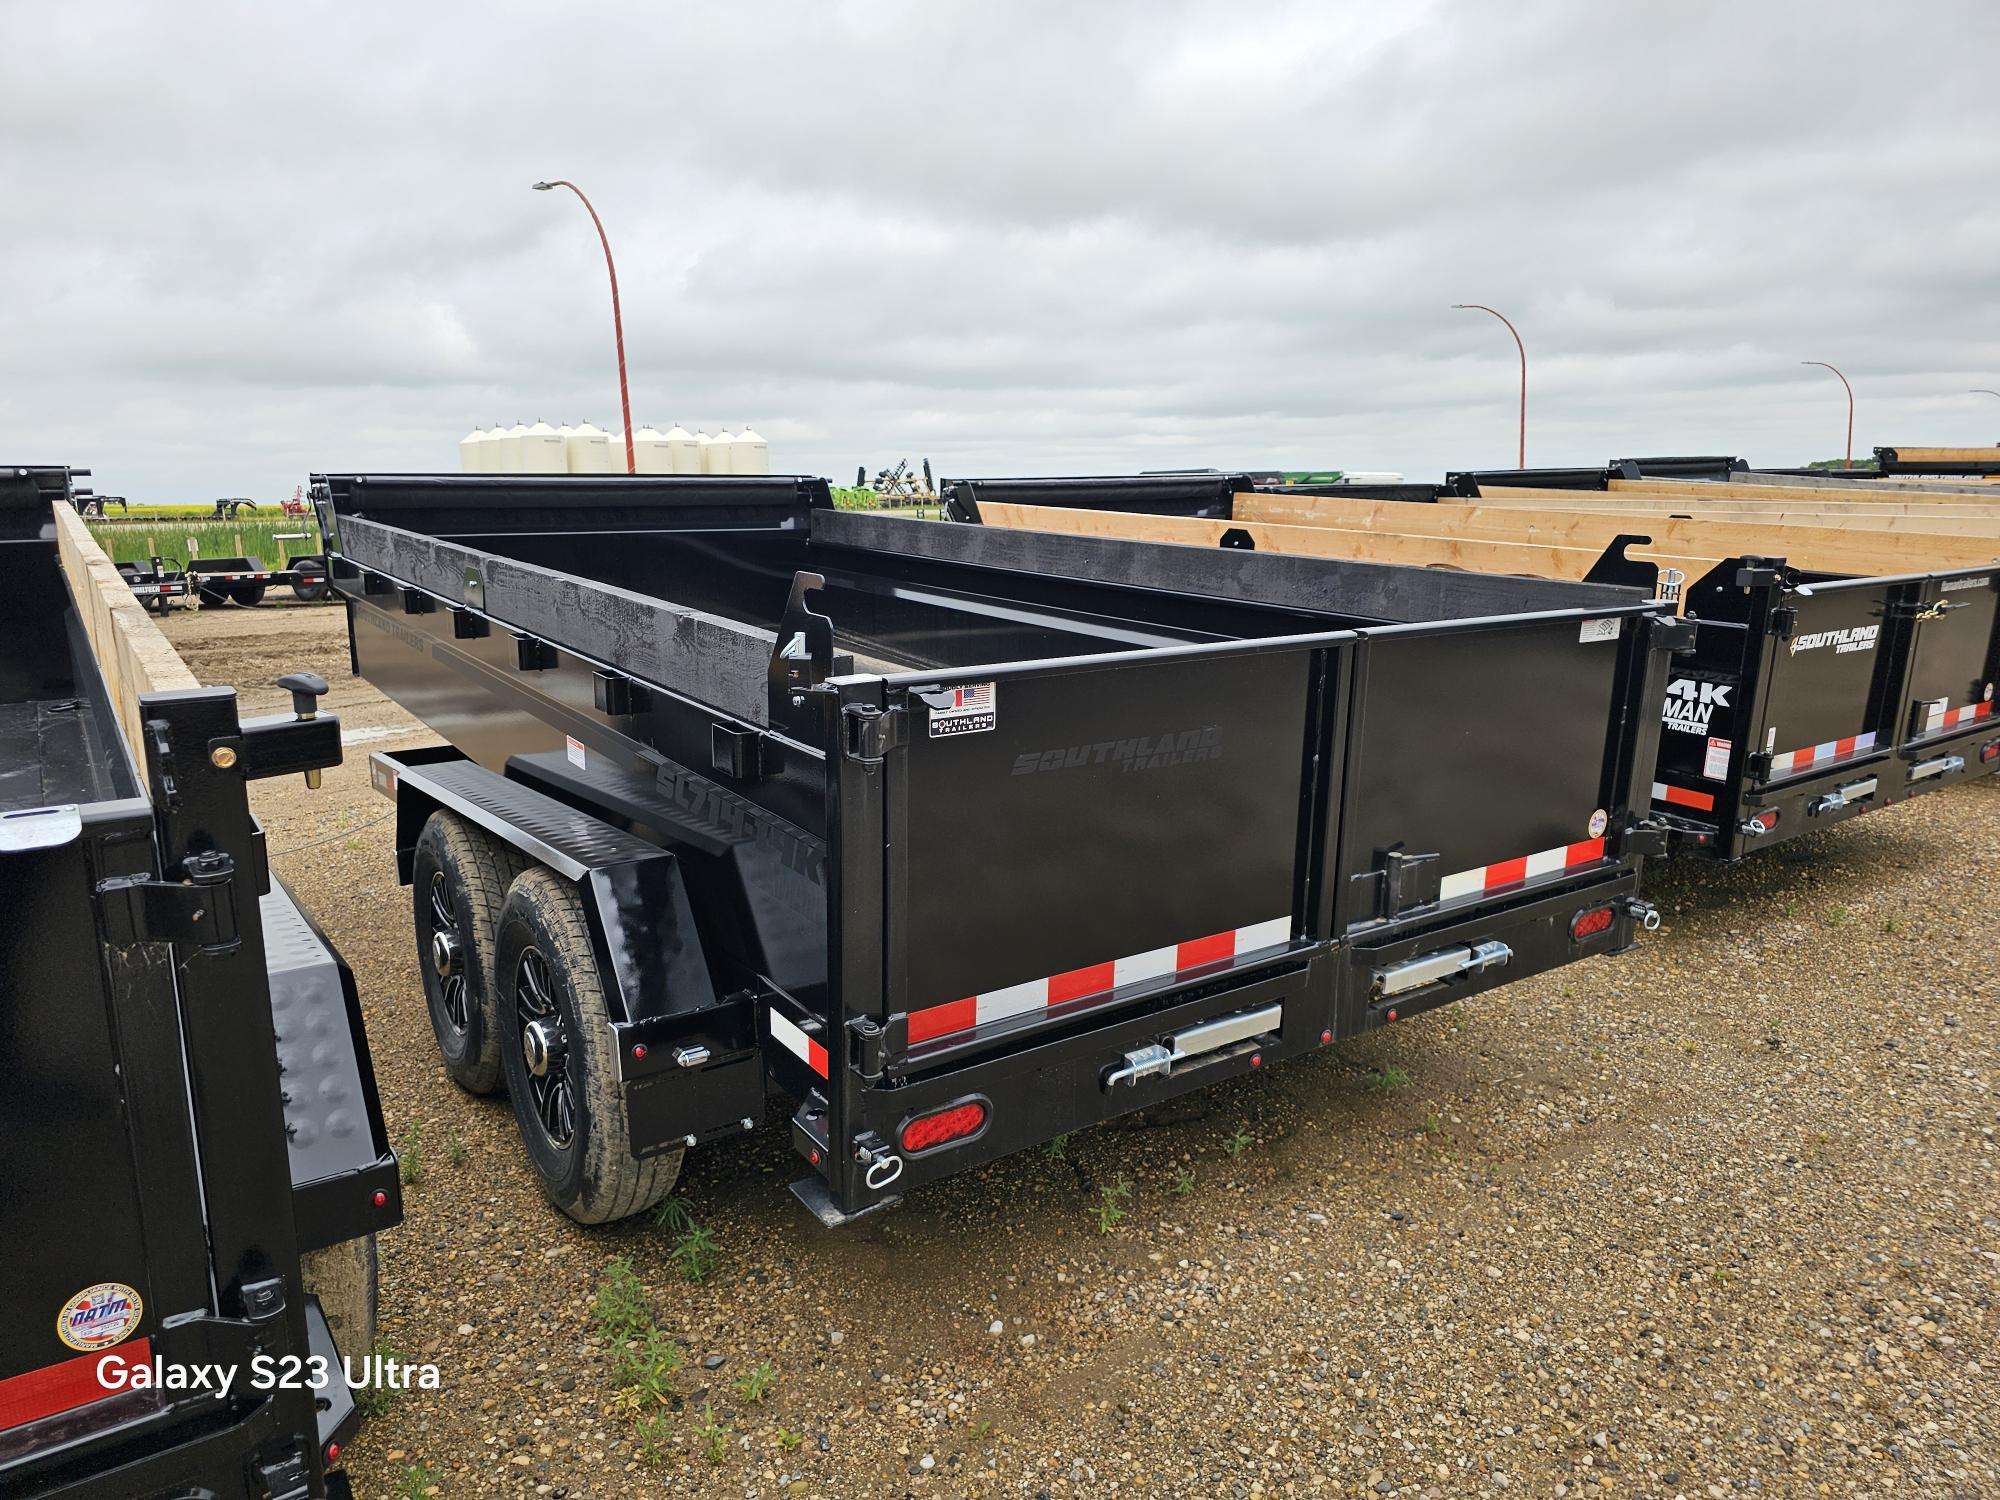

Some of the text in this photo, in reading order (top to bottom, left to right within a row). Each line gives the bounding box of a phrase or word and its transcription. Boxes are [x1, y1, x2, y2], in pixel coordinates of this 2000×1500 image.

[1797, 625, 1879, 651] SOUTHLAND
[1836, 640, 1876, 654] TRAILERS
[931, 715, 993, 729] SOUTHLAND
[938, 722, 987, 733] TRAILERS
[1667, 722, 1708, 736] TRAILERS
[1010, 727, 1219, 776] SOUTHLAND
